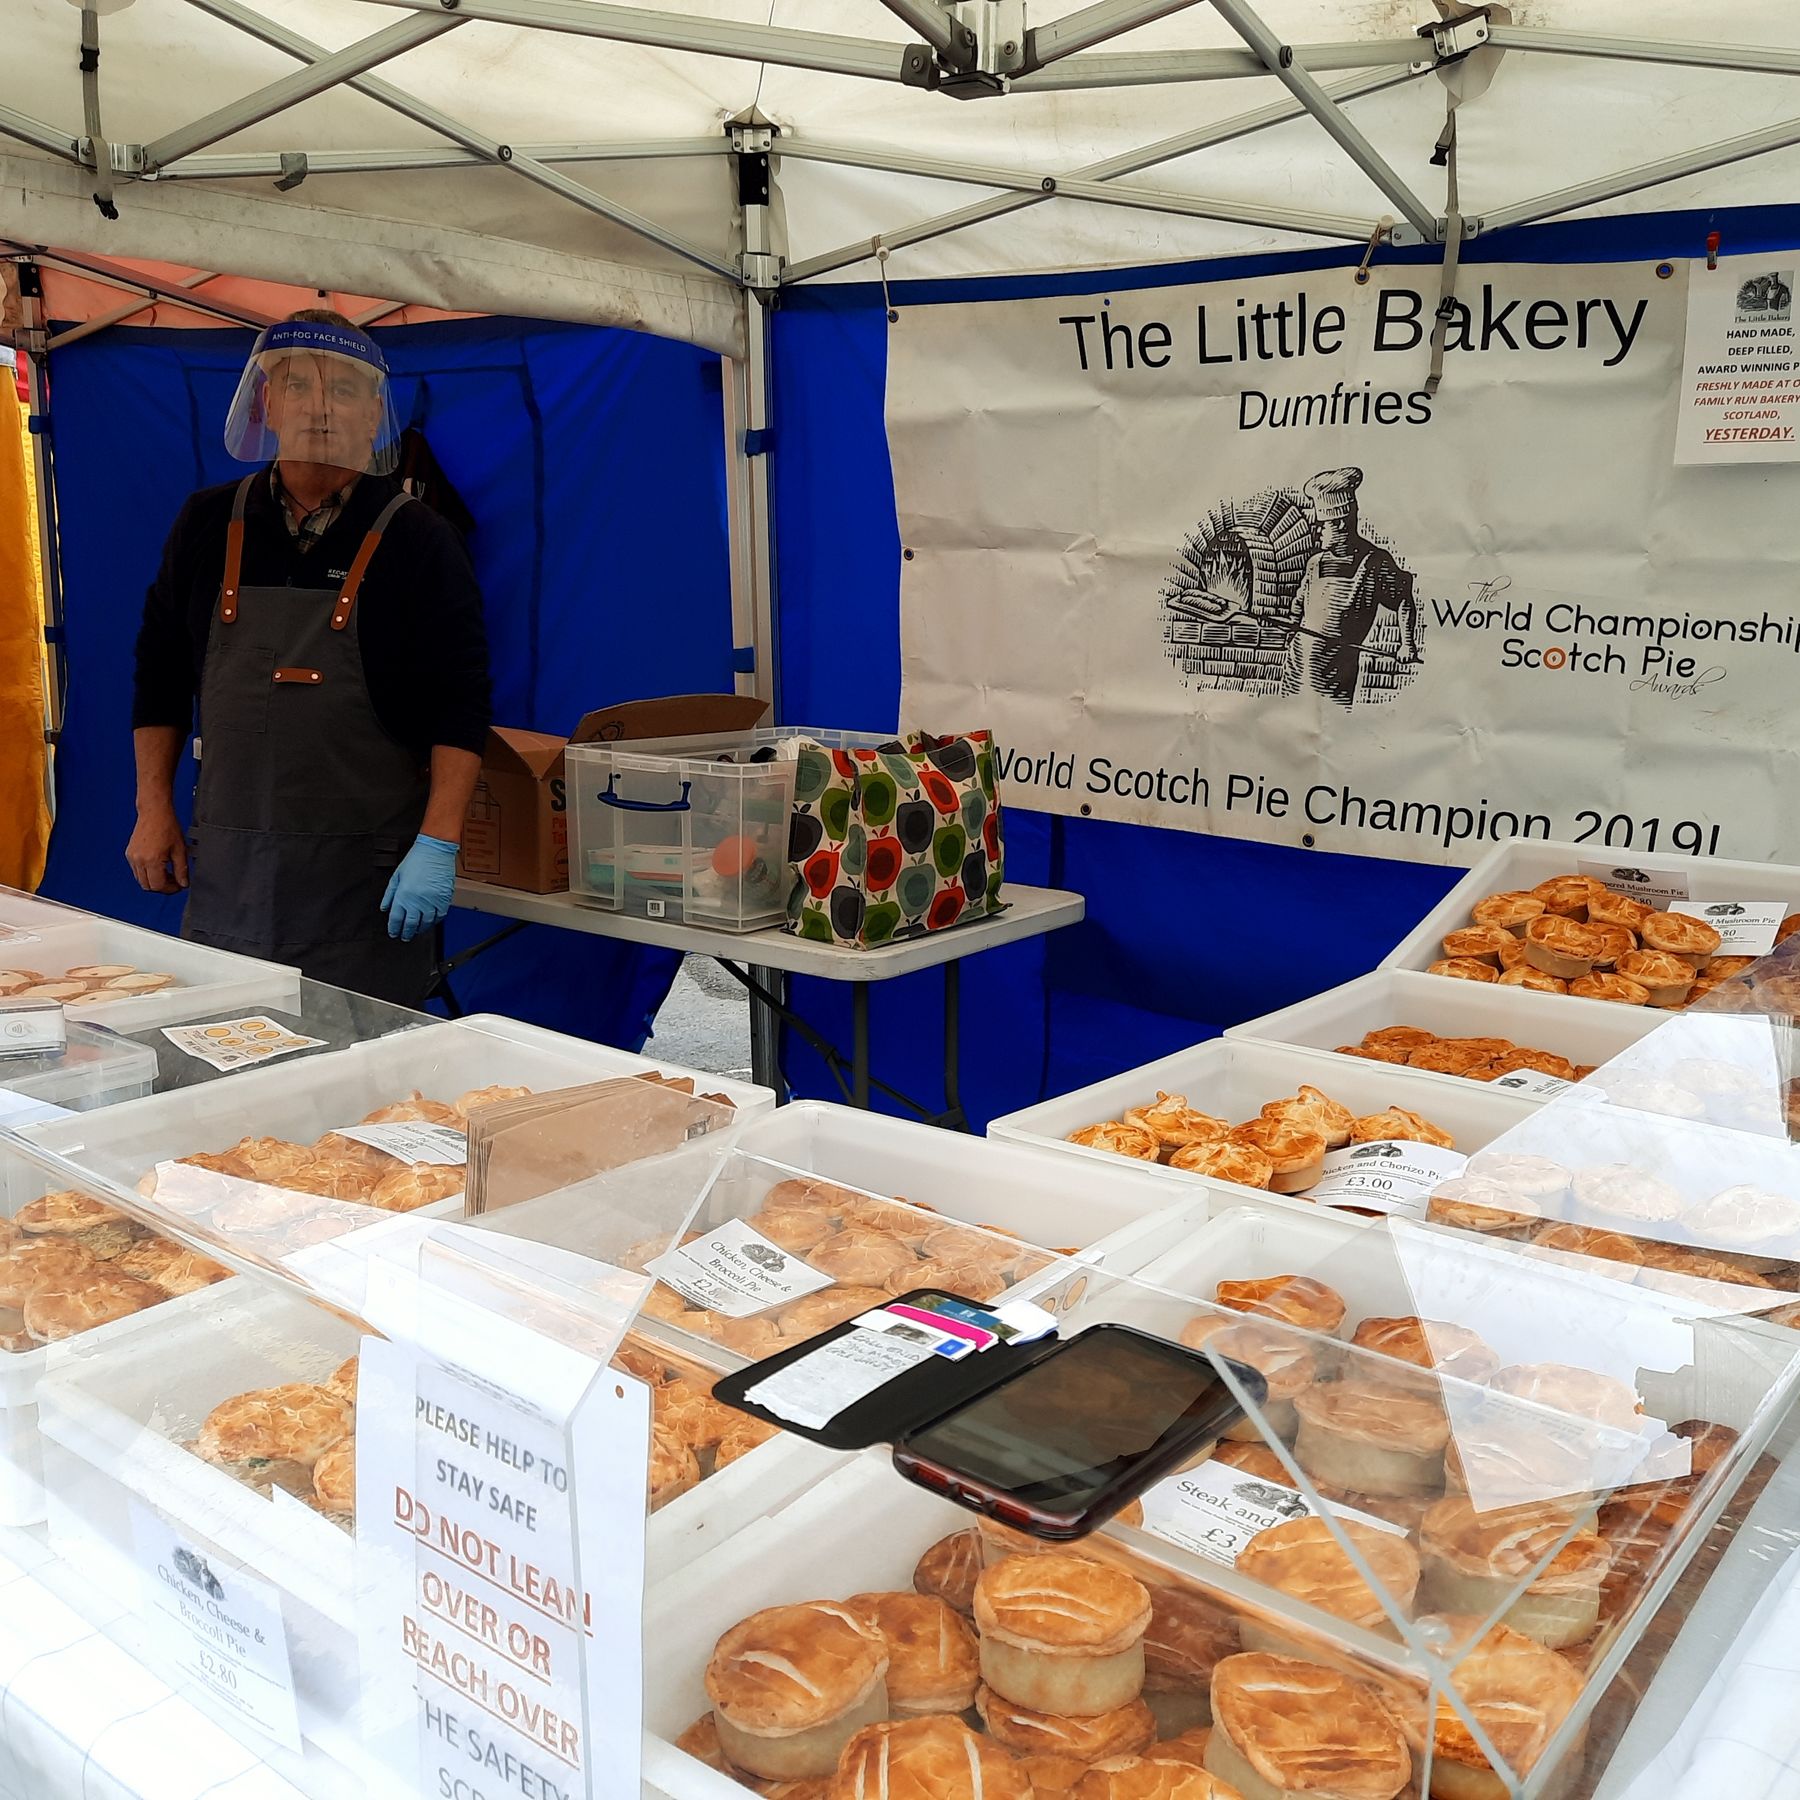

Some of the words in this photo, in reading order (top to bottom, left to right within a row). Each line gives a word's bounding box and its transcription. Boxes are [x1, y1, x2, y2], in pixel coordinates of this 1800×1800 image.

[272, 331, 311, 341] ANTI-FOG
[314, 333, 337, 343] FACE
[338, 337, 367, 352] SHIELD
[1059, 311, 1172, 371] The
[1199, 292, 1346, 365] Little
[1373, 284, 1649, 366] Bakery
[1726, 330, 1757, 339] HAND
[1760, 328, 1795, 337] MADE,
[1697, 364, 1738, 374] AWARD
[1740, 362, 1790, 373] WINNING
[1728, 346, 1754, 356] DEEP
[1756, 345, 1793, 355] FILLED,
[1694, 396, 1732, 406] FAMILY
[1734, 396, 1758, 405] RUN
[1760, 394, 1800, 404] BAKERY
[1696, 381, 1740, 391] FRESHLY
[1742, 380, 1775, 390] MADE
[1776, 379, 1791, 388] AT
[1239, 381, 1432, 431] Dumfries
[1723, 410, 1780, 420] SCOTLAND,
[1705, 427, 1795, 441] YESTERDAY.
[1468, 575, 1512, 604] The
[1431, 599, 1533, 631] World
[1501, 639, 1626, 675] Scotch
[1641, 646, 1696, 678] Pie
[1629, 666, 1727, 700] Awards
[1085, 757, 1209, 808] Scotch
[1226, 774, 1289, 819] Pie
[1304, 784, 1551, 848] Champion
[1627, 884, 1669, 895] Mushroom
[1322, 1164, 1355, 1176] hicken
[1357, 1160, 1377, 1168] and
[1380, 1160, 1425, 1175] Chorizo
[1345, 1176, 1393, 1190] £3.00
[708, 1258, 747, 1287] Broccoli
[744, 1280, 762, 1293] Pie
[710, 1241, 748, 1271] Chicken,
[749, 1267, 782, 1288] Cheese
[781, 1285, 792, 1293] &
[415, 1396, 480, 1450] PLEASE
[485, 1431, 535, 1474] HELP
[540, 1459, 568, 1493] TO
[436, 1459, 484, 1502] STAY
[488, 1487, 538, 1533] SAFE
[1176, 1480, 1234, 1513] Steak
[1235, 1507, 1279, 1529] and
[395, 1486, 431, 1536] DO
[440, 1516, 501, 1577] NOT
[510, 1555, 591, 1627] LEAN
[1200, 1528, 1239, 1554] £3.
[157, 1564, 205, 1610] Chicken,
[206, 1600, 250, 1637] Cheese
[254, 1628, 267, 1645] &
[179, 1600, 224, 1643] Broccoli
[227, 1633, 247, 1658] Pie
[422, 1571, 498, 1645] OVER
[508, 1623, 551, 1676] OR
[199, 1650, 238, 1690] £2.80
[403, 1615, 487, 1702] REACH
[498, 1683, 579, 1762] OVER
[468, 1729, 570, 1800] SAFETY
